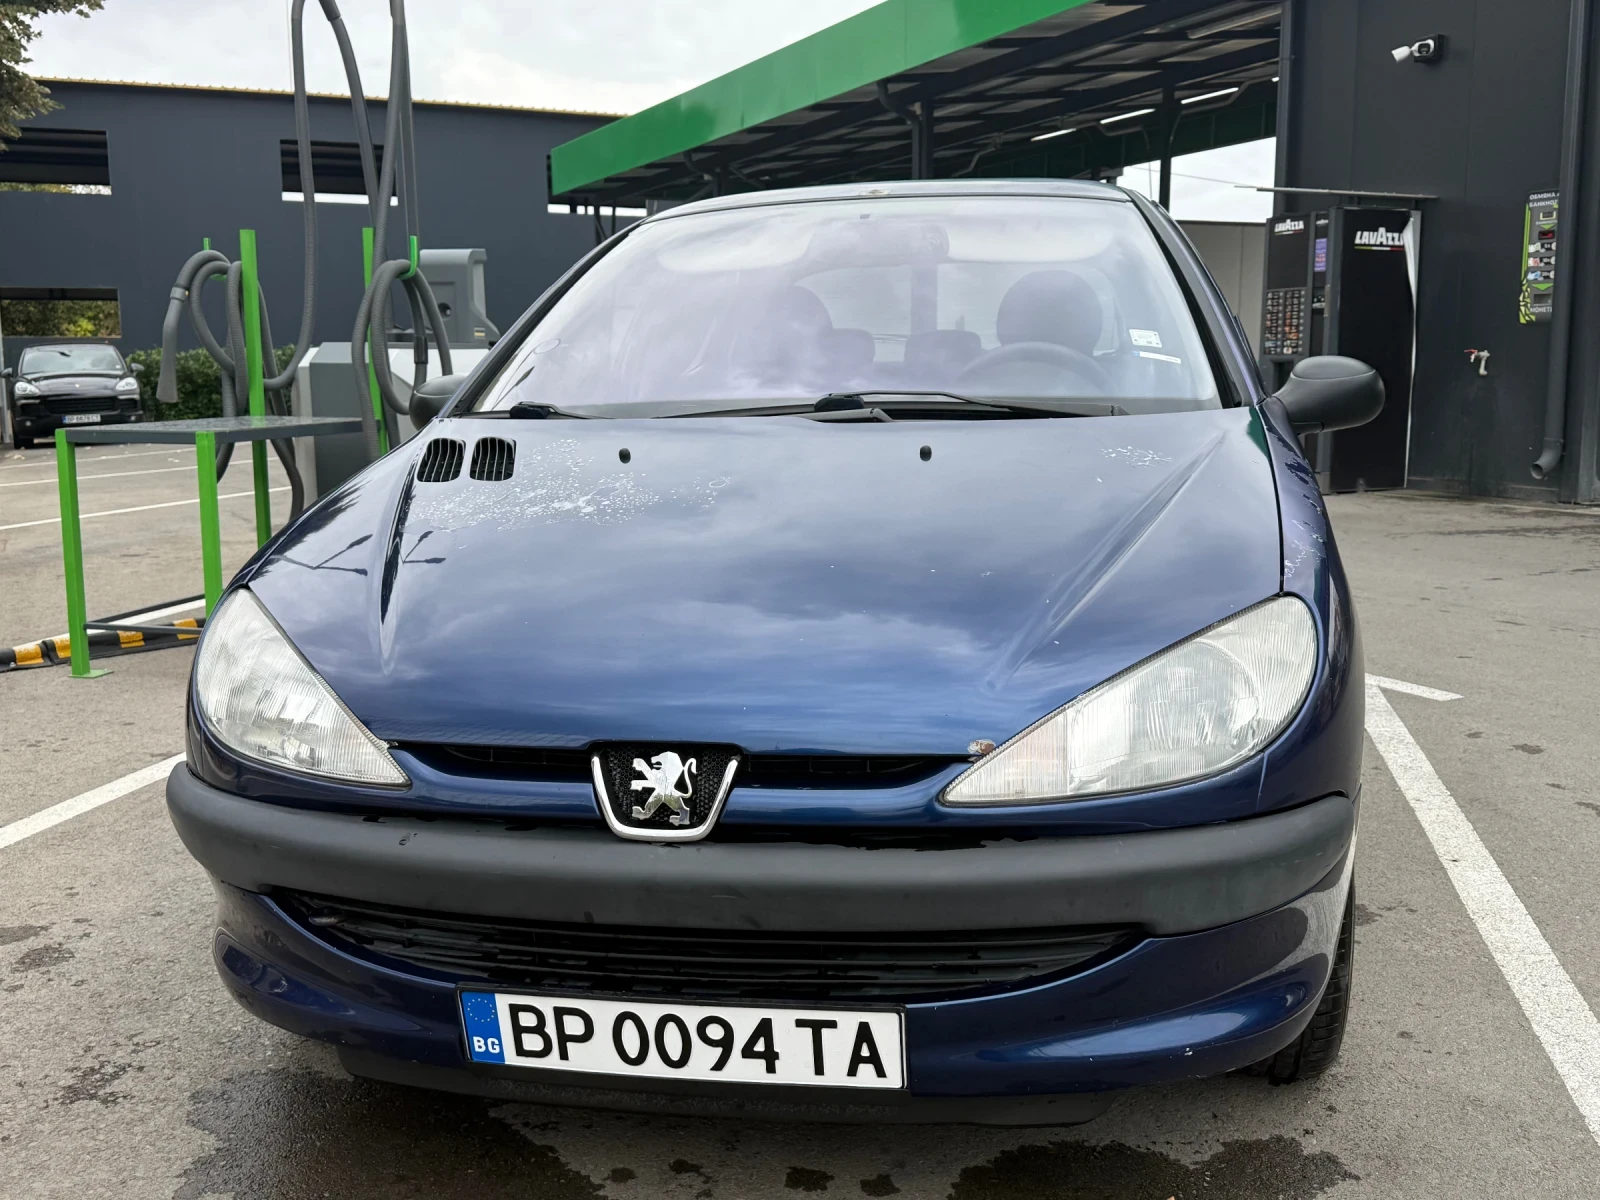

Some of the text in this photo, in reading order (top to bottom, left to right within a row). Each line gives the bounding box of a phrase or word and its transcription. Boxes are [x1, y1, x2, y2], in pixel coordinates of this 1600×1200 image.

[473, 1036, 500, 1054] BG
[508, 1003, 887, 1079] BP 0094 TA
